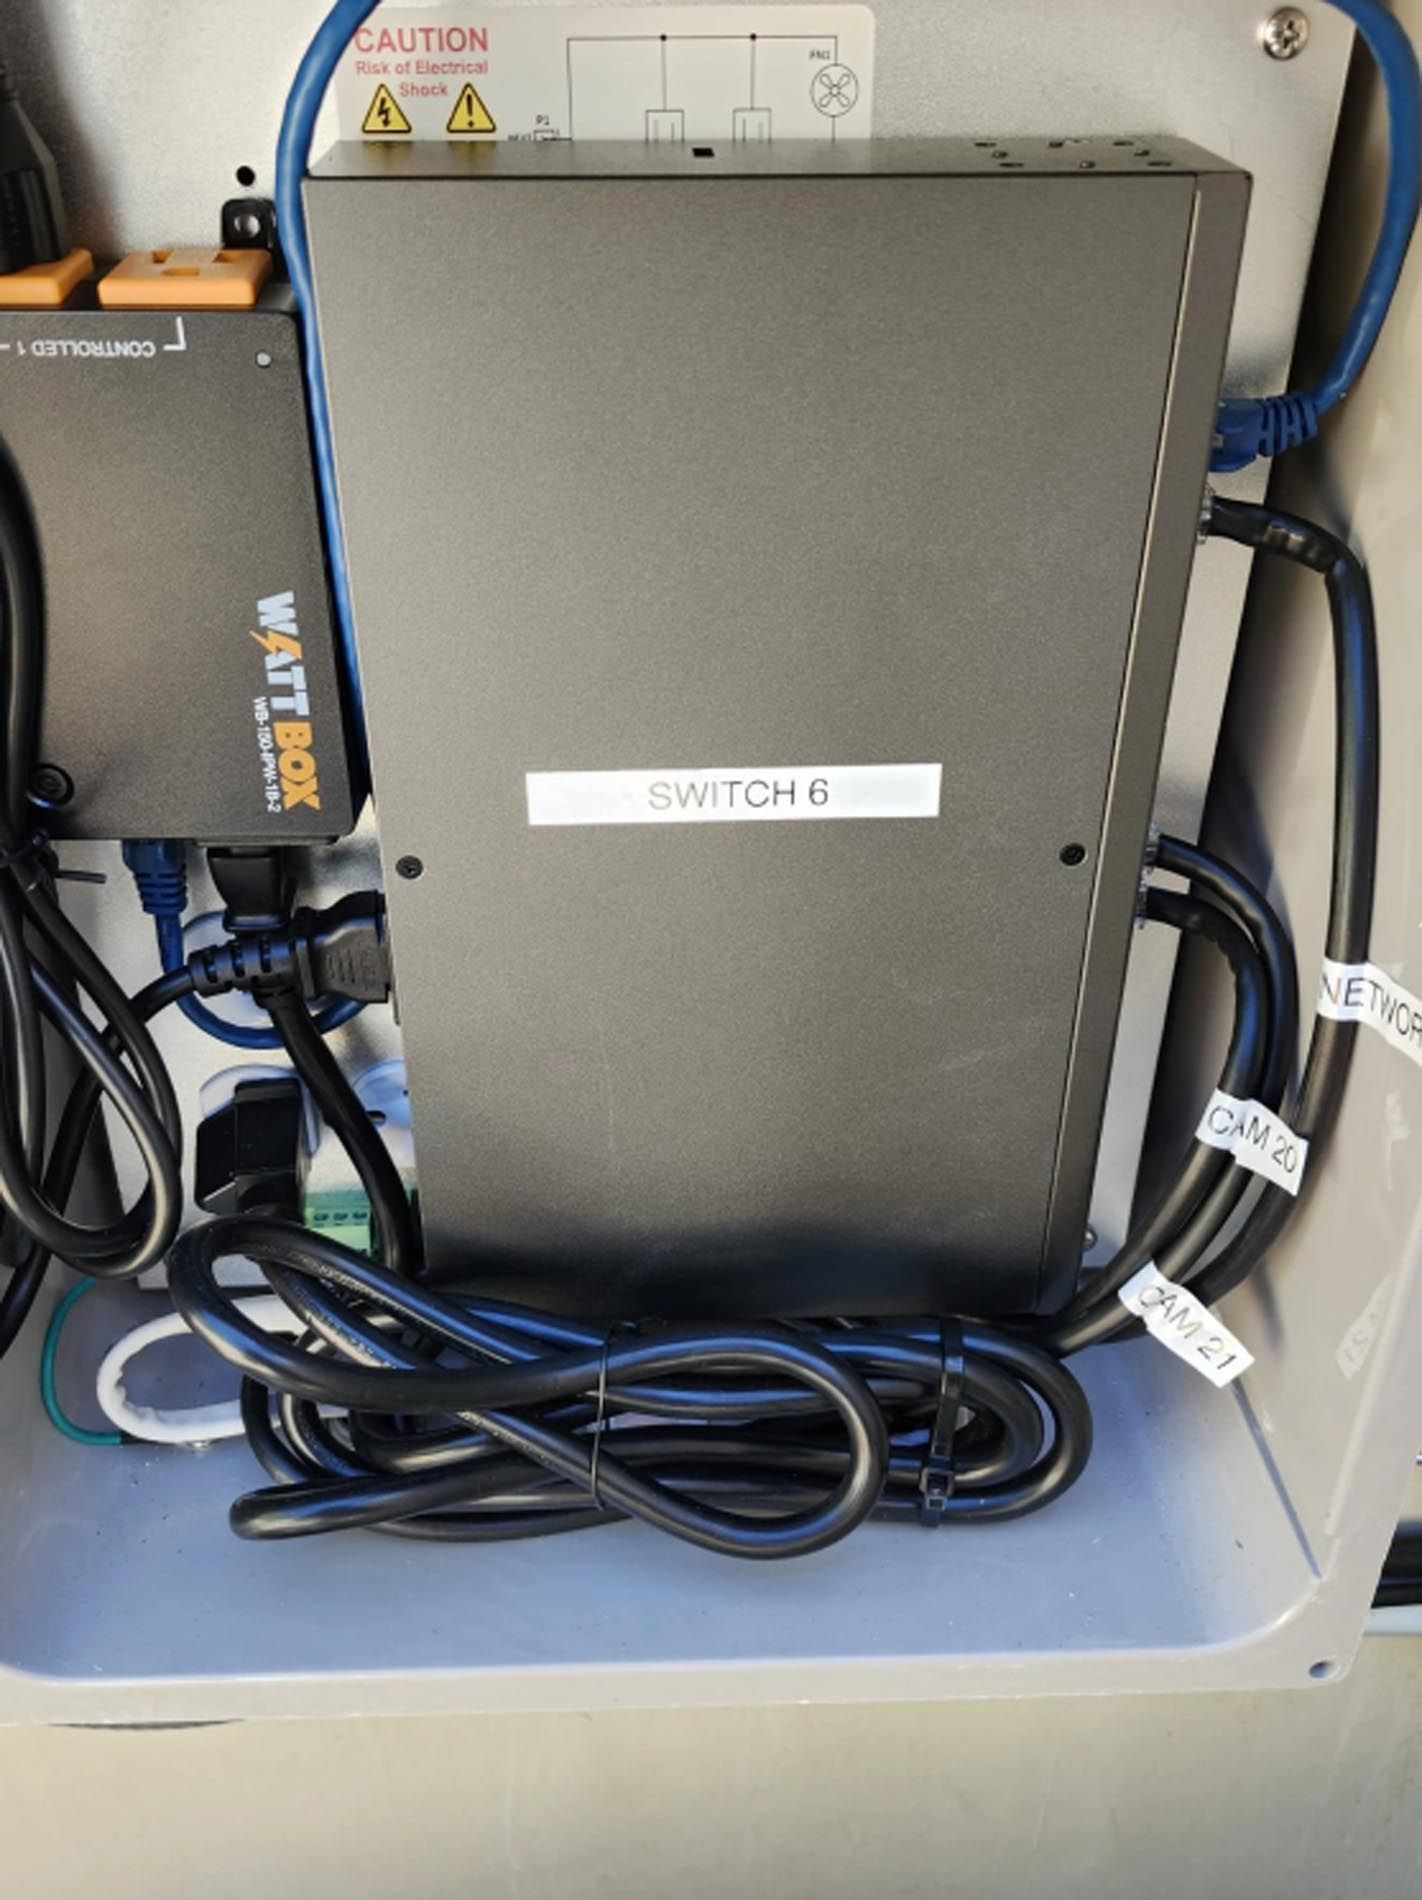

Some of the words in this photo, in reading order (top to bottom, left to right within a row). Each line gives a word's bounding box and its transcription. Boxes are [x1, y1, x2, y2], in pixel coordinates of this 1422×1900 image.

[354, 27, 488, 52] CAUTION
[355, 61, 390, 75] Risk
[395, 61, 410, 75] of
[416, 60, 488, 75] Electrical
[399, 82, 448, 97] Shock
[17, 341, 27, 356] 1
[31, 340, 156, 358] CONTROLLED
[648, 779, 796, 810] SWITCH
[808, 778, 829, 807] 6
[1208, 1106, 1271, 1151] CAM
[1272, 1136, 1297, 1173] 20
[1139, 1286, 1203, 1339] CAM
[1197, 1336, 1236, 1370] 21
